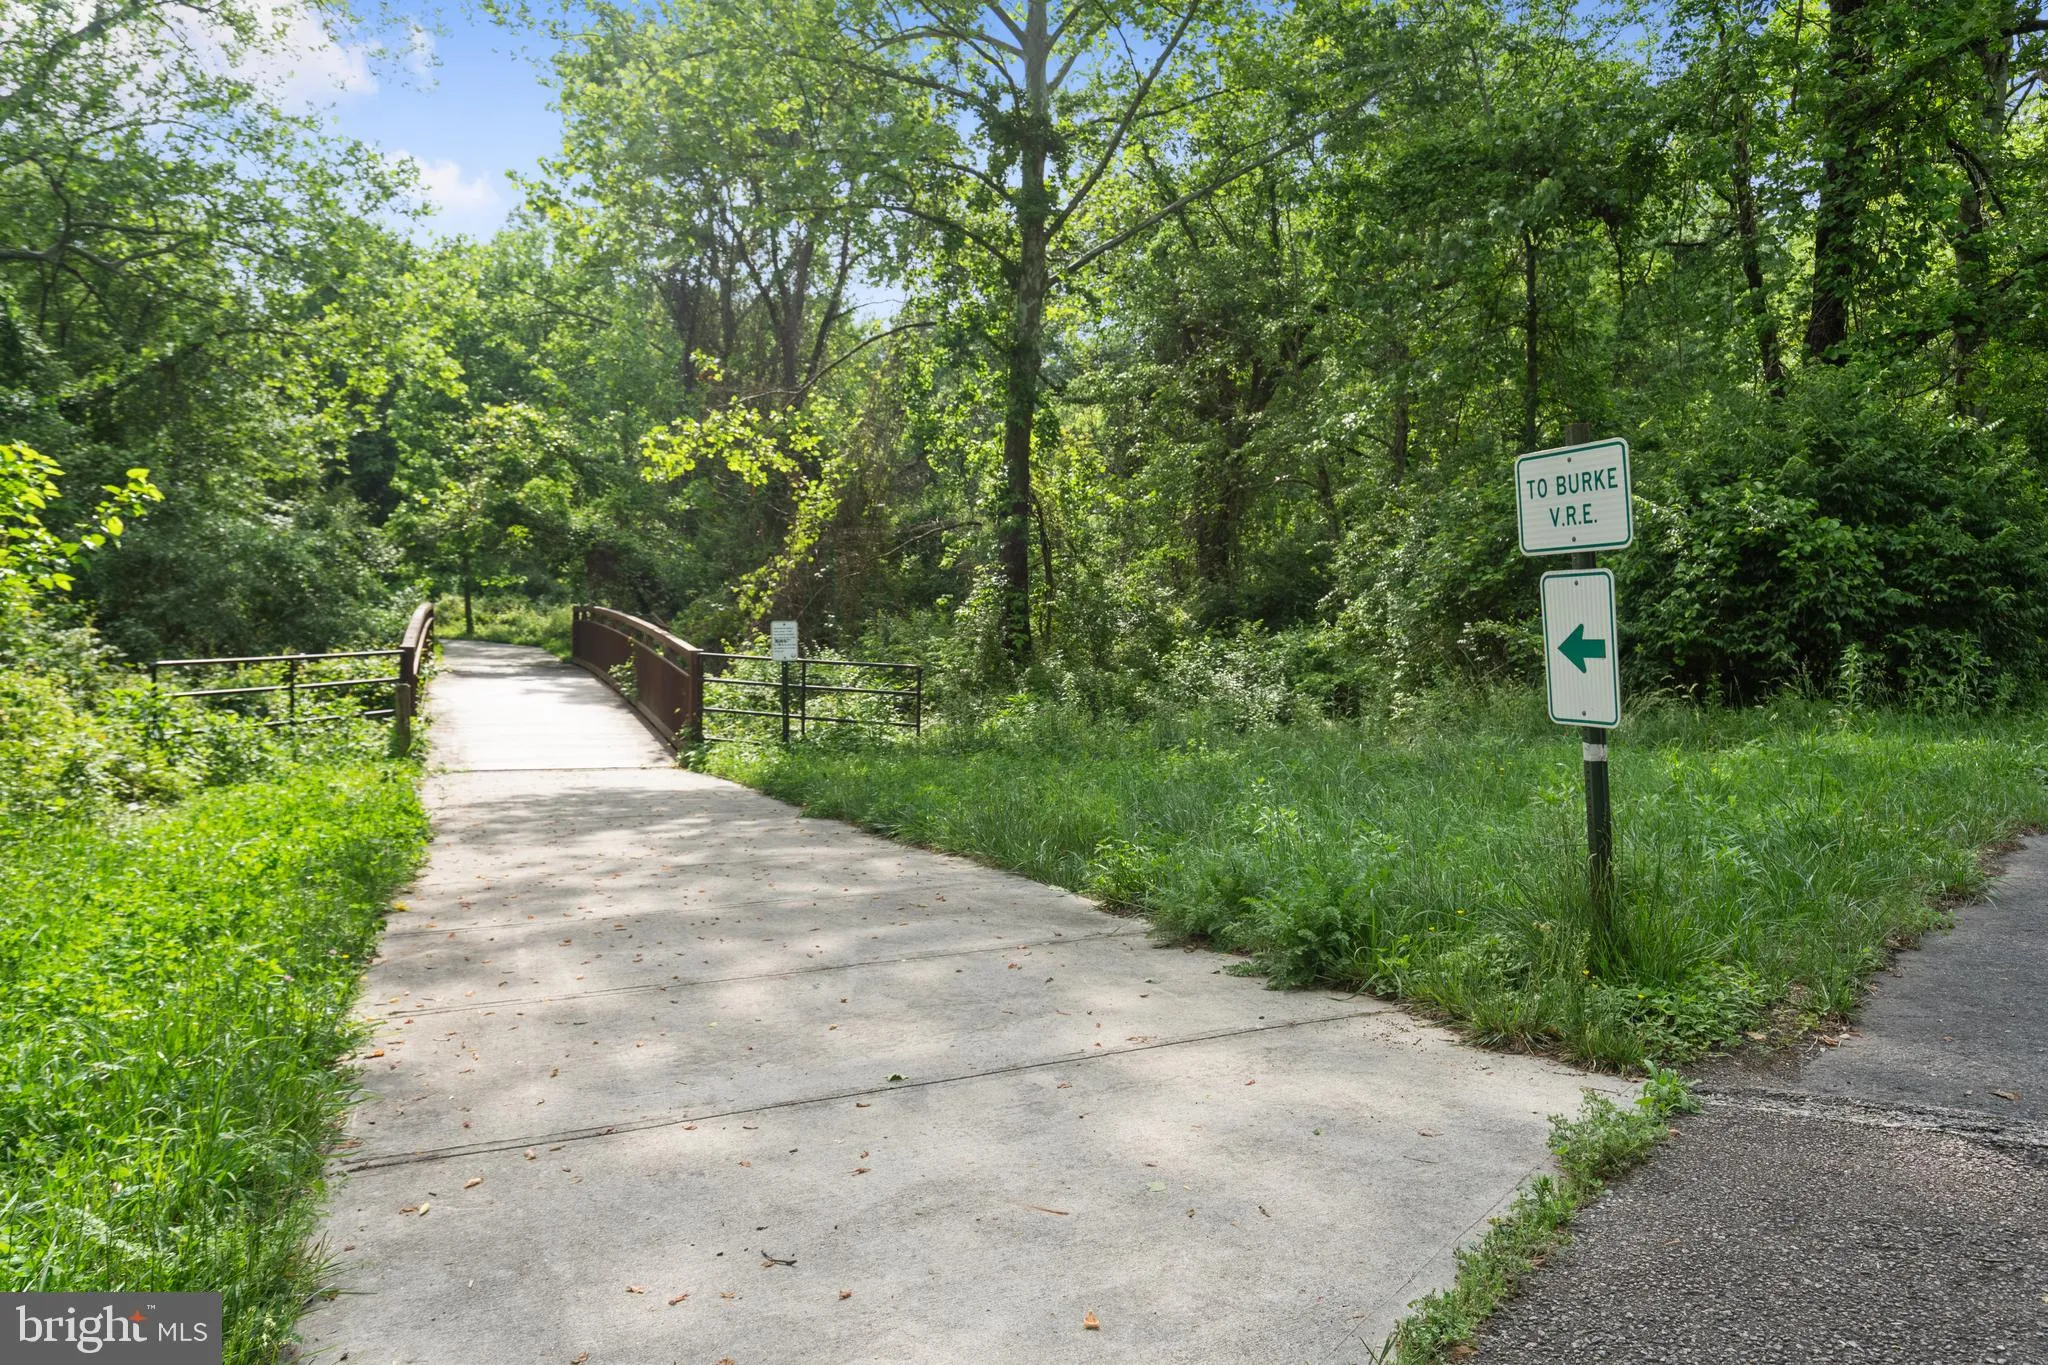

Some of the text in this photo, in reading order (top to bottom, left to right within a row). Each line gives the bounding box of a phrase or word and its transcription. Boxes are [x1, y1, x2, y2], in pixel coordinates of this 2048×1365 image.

[1526, 467, 1618, 499] TO BURKE
[1549, 503, 1598, 527] V.R.E.
